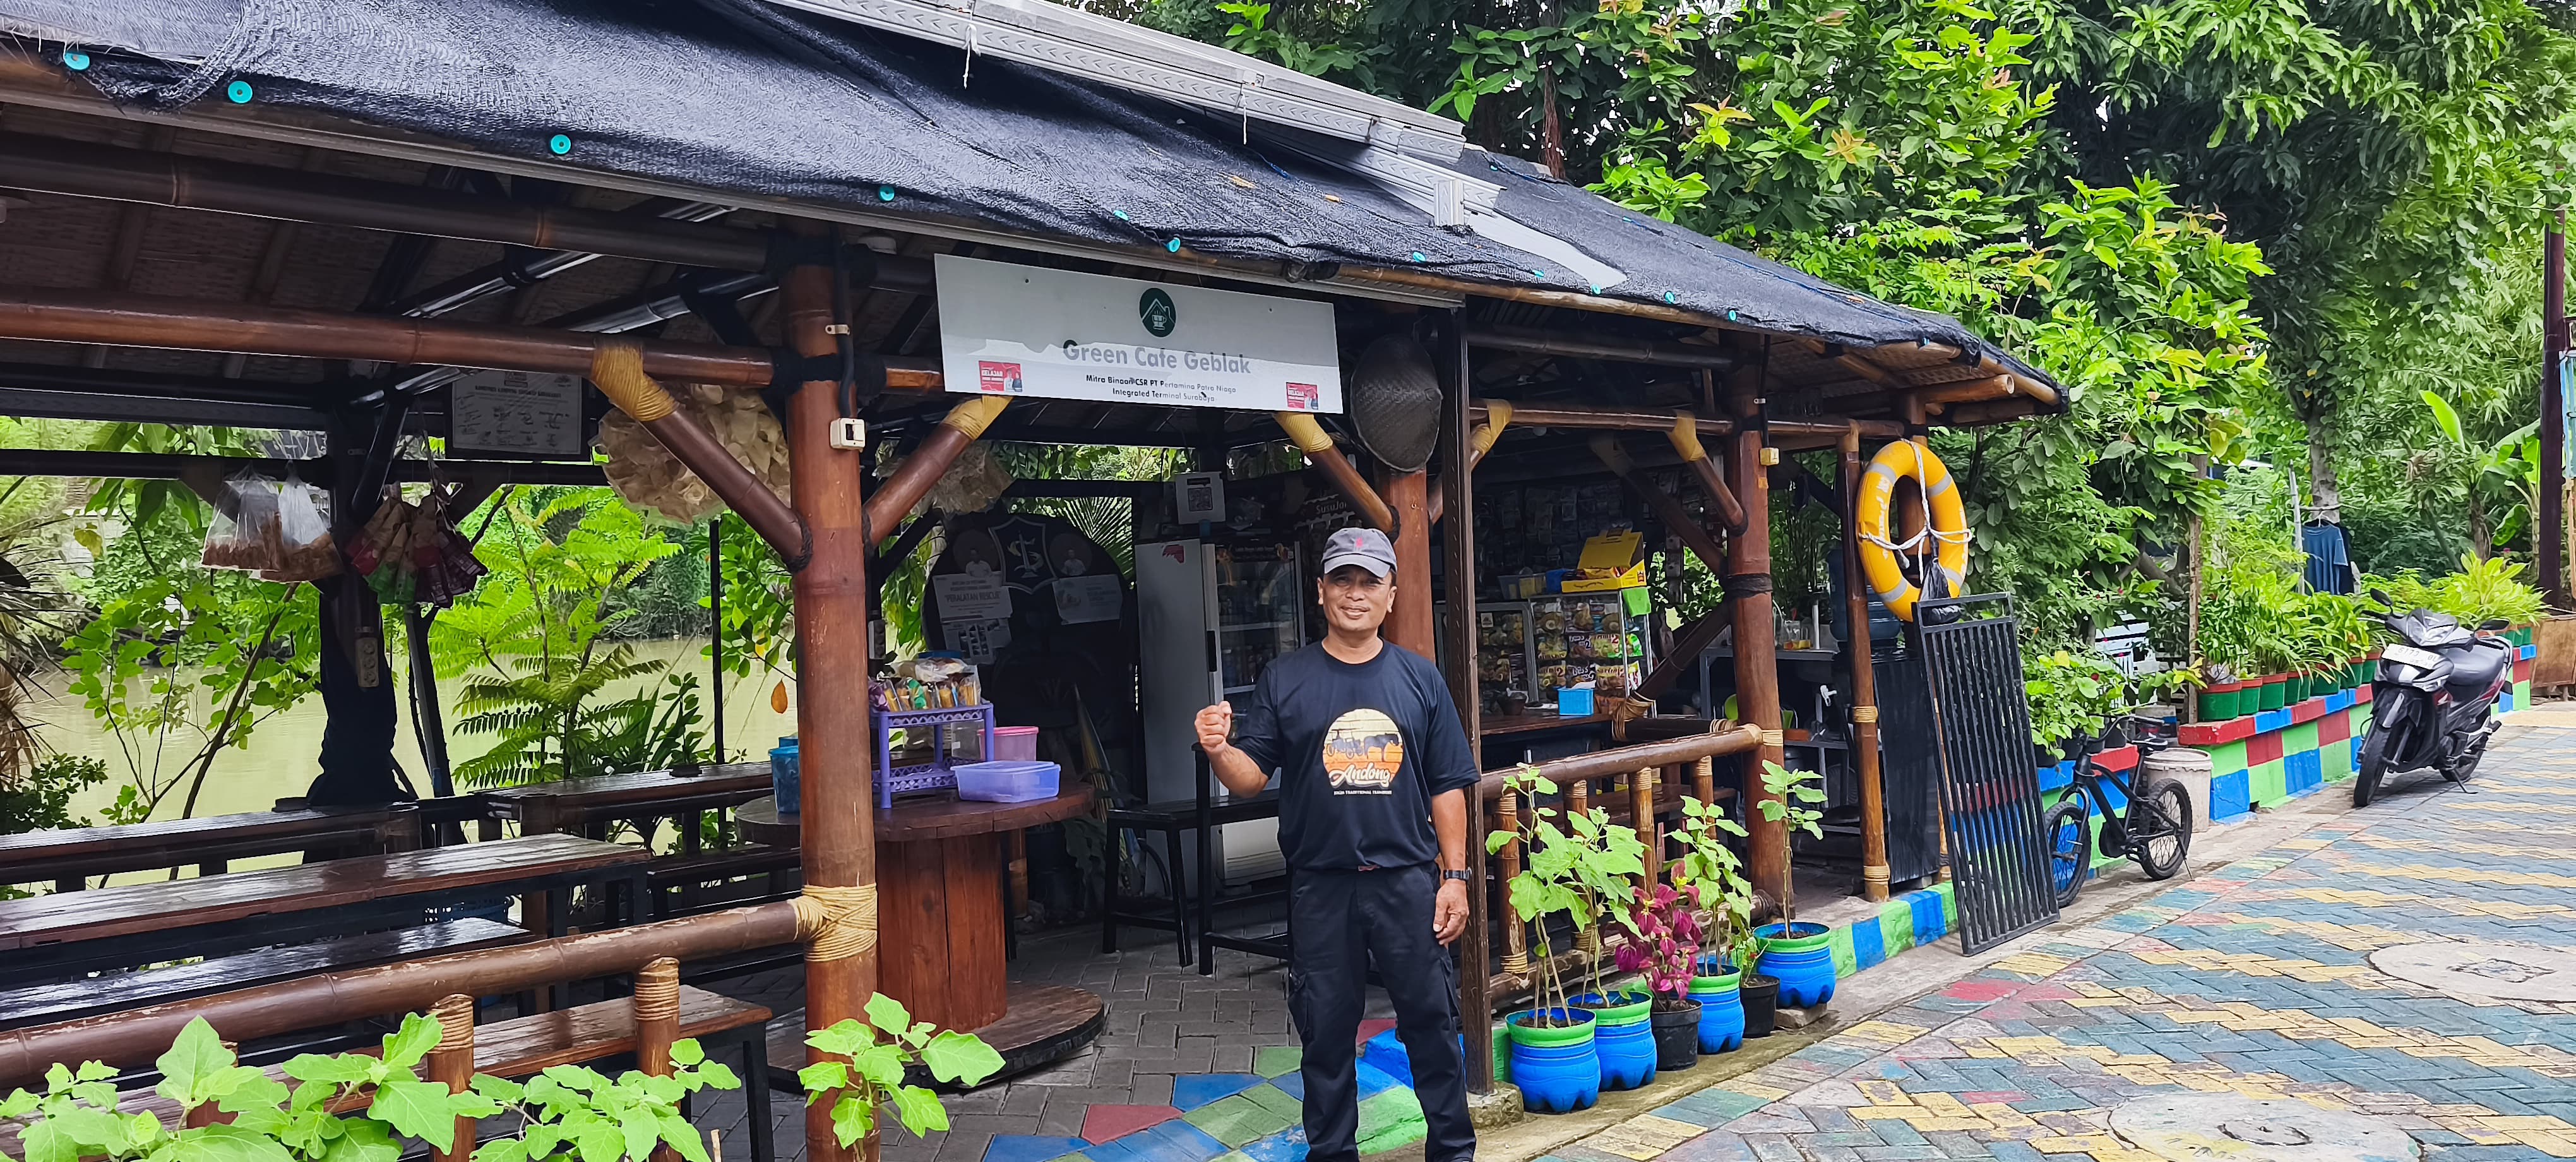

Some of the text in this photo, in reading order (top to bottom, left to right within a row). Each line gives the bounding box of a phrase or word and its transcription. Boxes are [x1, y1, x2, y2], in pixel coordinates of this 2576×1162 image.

[1063, 339, 1251, 374] Green Cafe Geblak
[1086, 374, 1106, 383] Mitra
[1108, 376, 1133, 385] Binaan
[1160, 381, 1195, 390] Pertamina
[1217, 385, 1236, 393] Niaga
[1112, 388, 1215, 403] Integrated Terminal Surabaya
[1329, 762, 1391, 788] Andong
